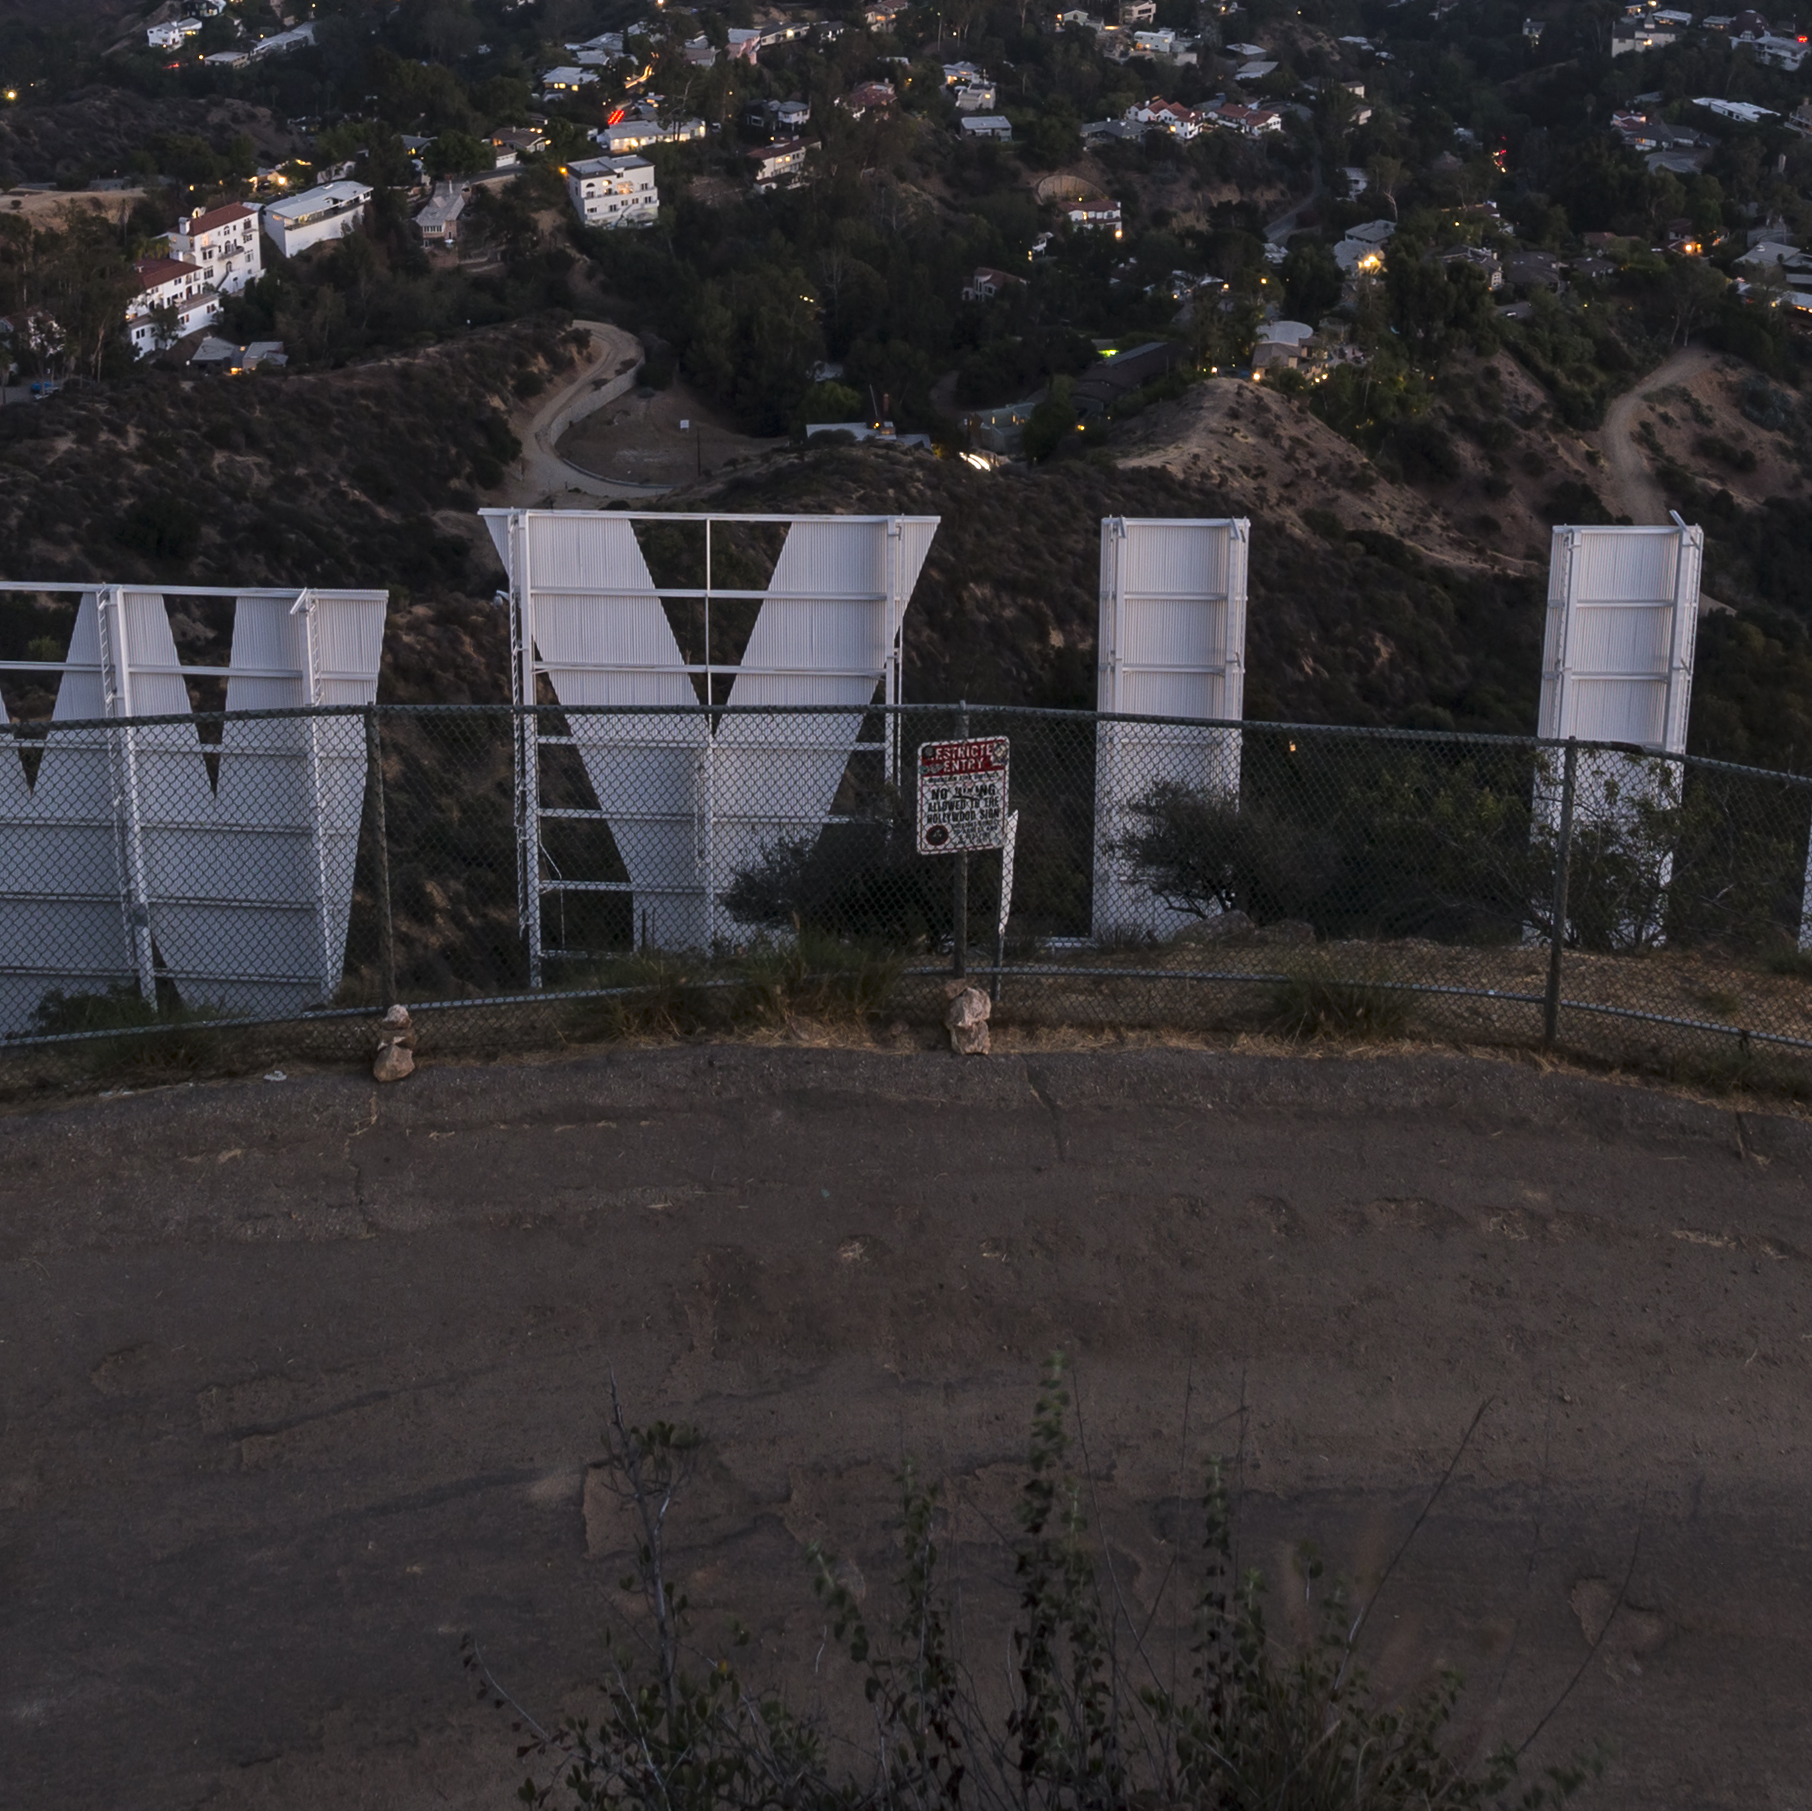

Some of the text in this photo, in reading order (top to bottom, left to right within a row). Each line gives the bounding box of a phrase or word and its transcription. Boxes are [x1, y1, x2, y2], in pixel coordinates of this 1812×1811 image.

[931, 744, 993, 760] ESTRICTE
[944, 758, 984, 772] ENTRY
[931, 788, 947, 800] NO
[928, 797, 1000, 811] ALLOWED TO THE
[927, 807, 1000, 824] HOLLYWOOD SIGN
